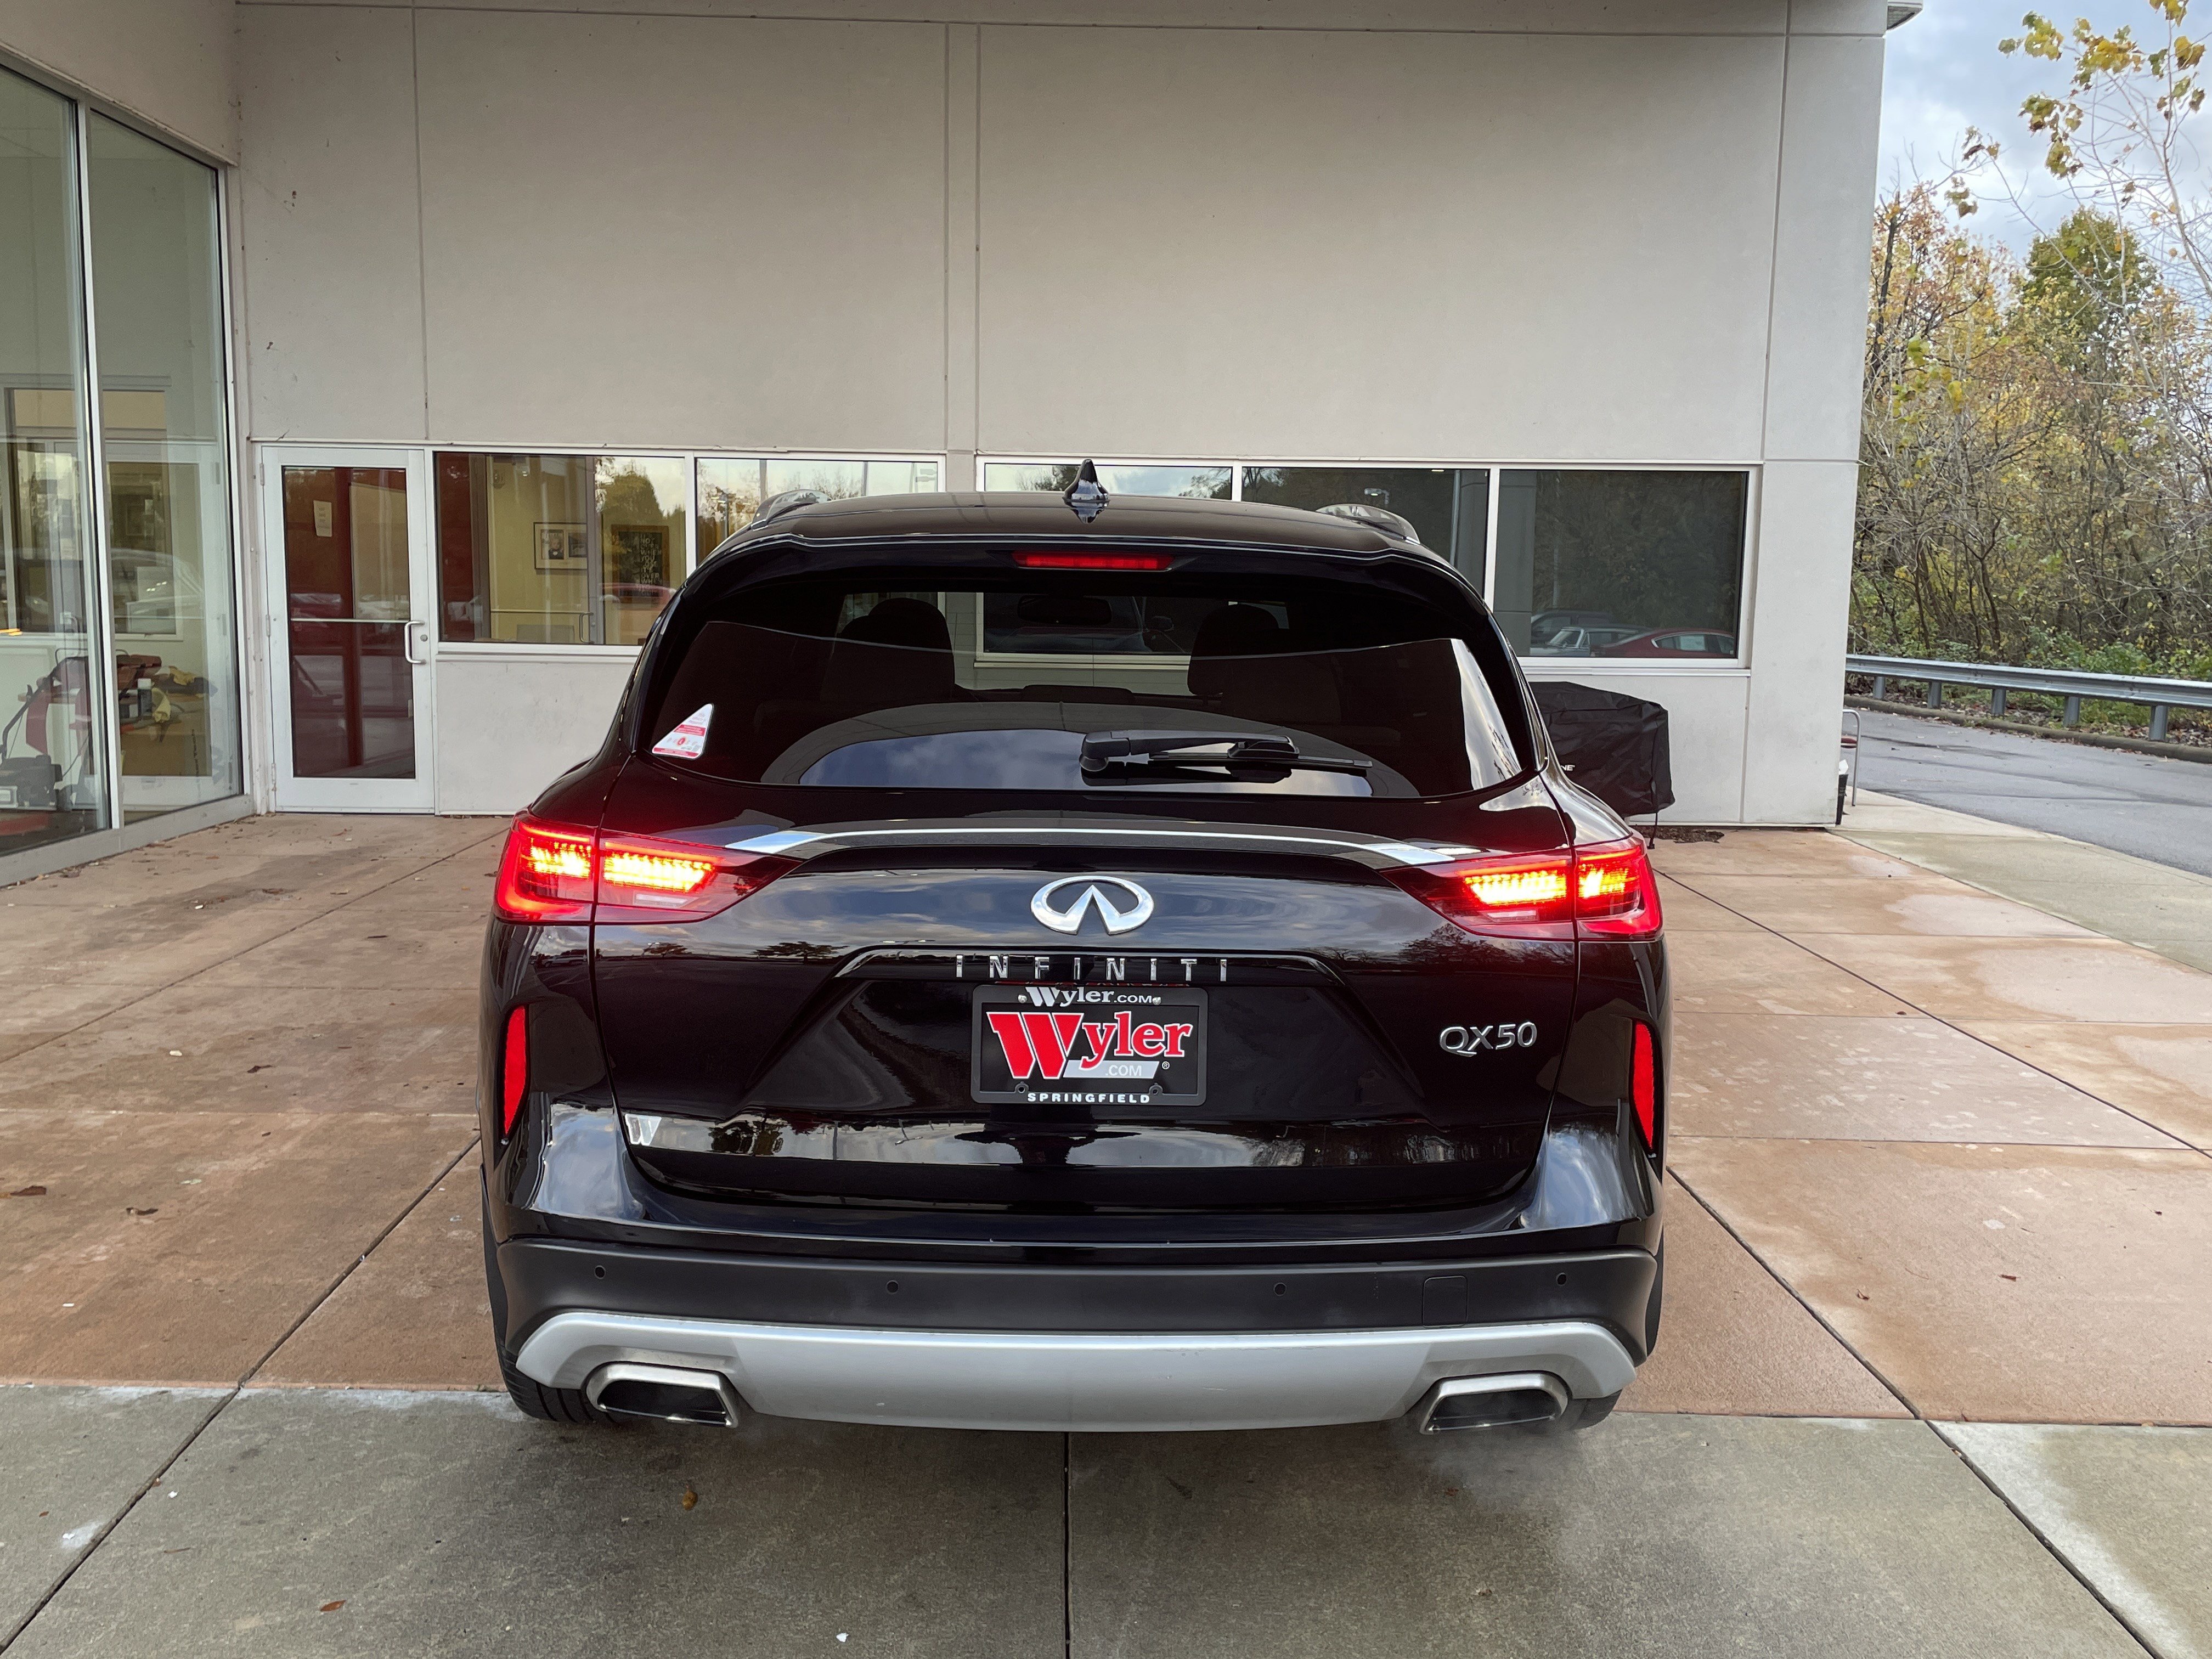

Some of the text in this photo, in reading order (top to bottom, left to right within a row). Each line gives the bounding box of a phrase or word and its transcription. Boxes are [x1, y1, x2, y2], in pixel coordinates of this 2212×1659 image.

[955, 955, 1227, 981] INFINITI
[986, 1011, 1193, 1079] Wyler
[1440, 1021, 1537, 1057] QX50
[1028, 1092, 1150, 1103] SPRINGFIELD
